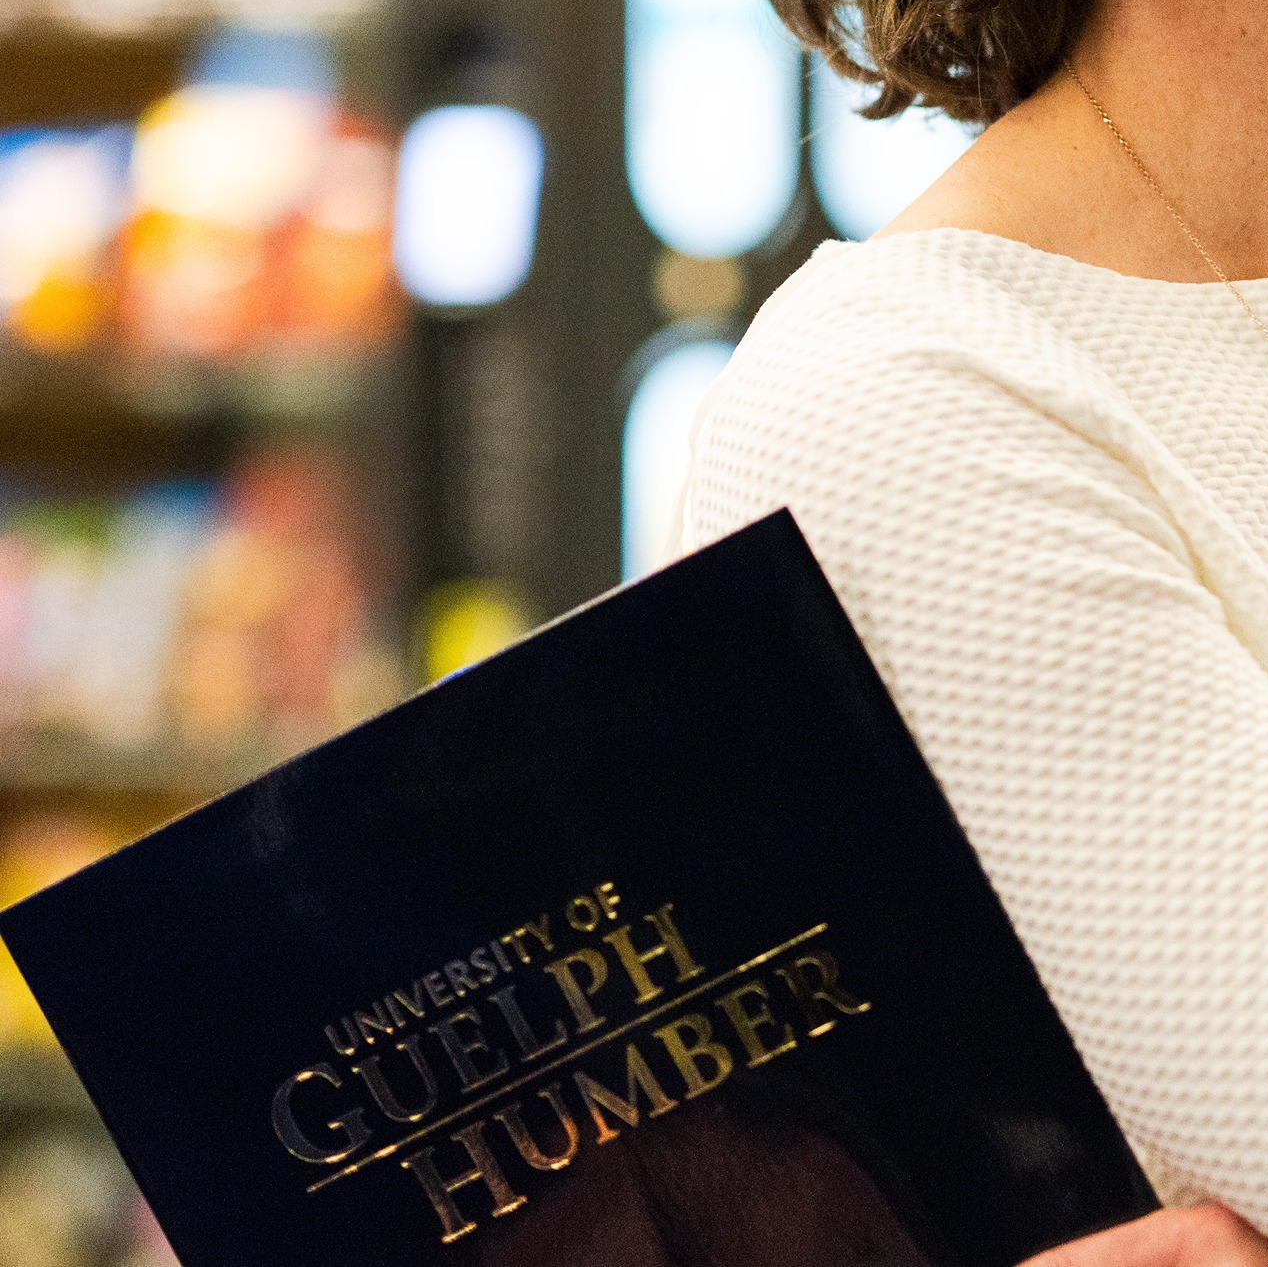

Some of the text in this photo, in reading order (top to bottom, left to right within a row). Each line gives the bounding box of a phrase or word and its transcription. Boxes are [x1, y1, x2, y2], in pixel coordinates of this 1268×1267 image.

[270, 903, 705, 1165] GUELPH
[323, 881, 622, 1056] UNIVERSITY OF
[401, 950, 872, 1245] HUMBER
